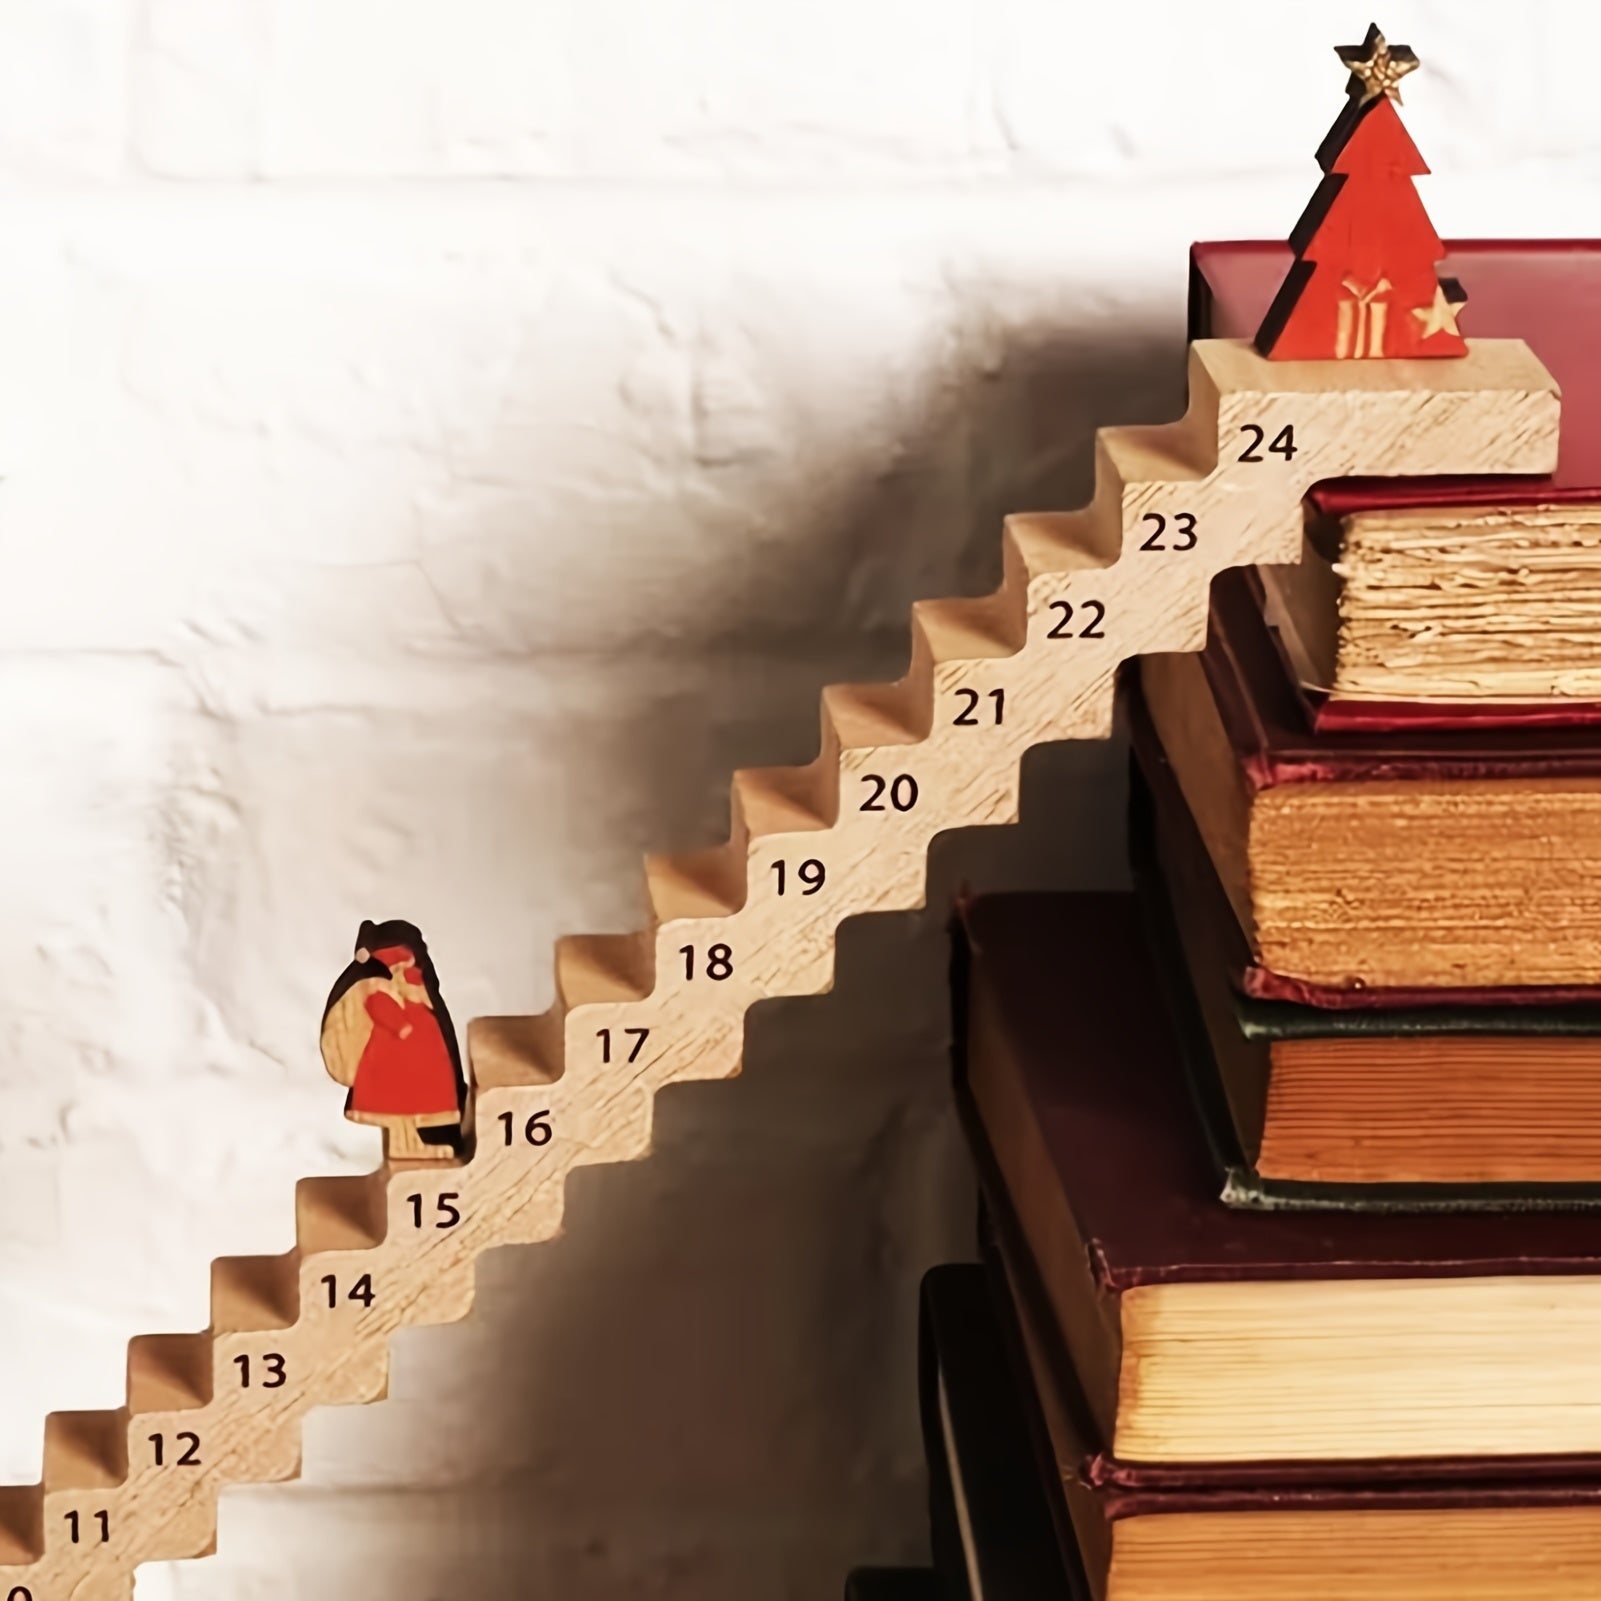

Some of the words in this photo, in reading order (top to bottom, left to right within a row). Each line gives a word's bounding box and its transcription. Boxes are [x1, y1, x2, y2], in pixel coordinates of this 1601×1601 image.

[1237, 424, 1298, 463] 24
[1139, 512, 1198, 552] 23
[1046, 599, 1105, 639] 22
[952, 687, 1005, 726] 21
[859, 773, 919, 812] 20
[770, 858, 826, 896] 19
[679, 943, 734, 981] 18
[596, 1028, 650, 1064] 17
[497, 1109, 553, 1147] 16
[406, 1192, 461, 1229] 15
[320, 1273, 376, 1309] 14
[233, 1352, 287, 1389] 13
[148, 1431, 202, 1466] 12
[63, 1509, 110, 1544] 11
